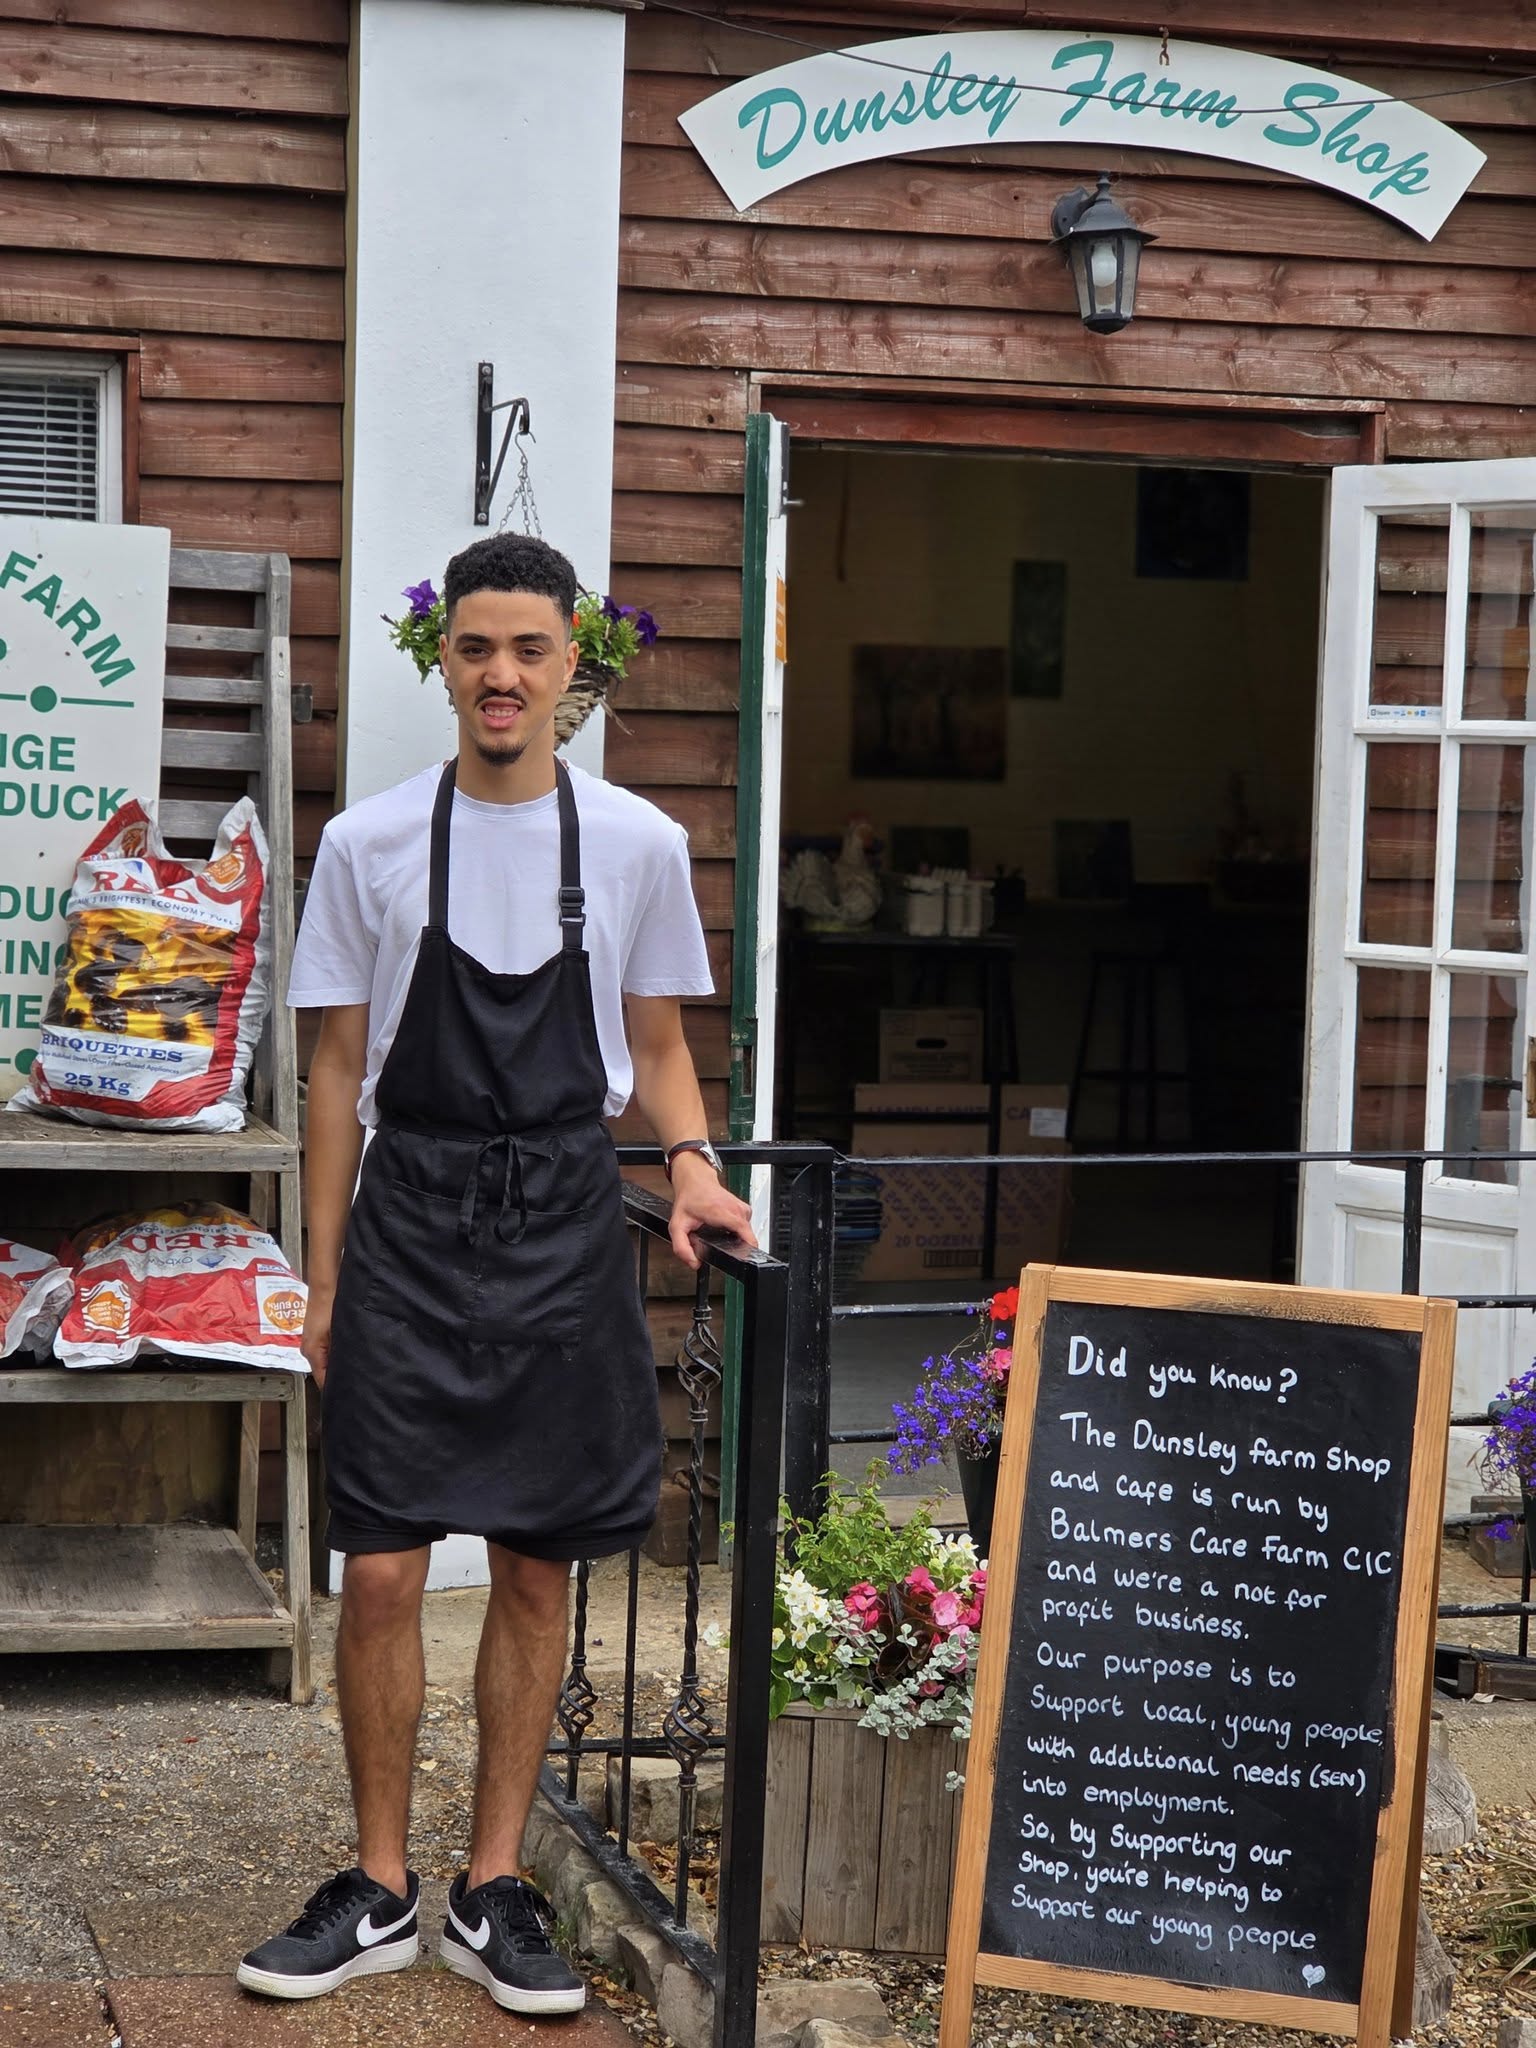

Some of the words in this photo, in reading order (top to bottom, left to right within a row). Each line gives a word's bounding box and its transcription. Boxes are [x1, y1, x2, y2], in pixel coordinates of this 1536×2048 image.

[738, 50, 1023, 171] Dunsley
[1051, 40, 1243, 130] Farm
[1261, 82, 1431, 198] Shop
[0, 551, 136, 688] FARM
[0, 733, 76, 771] GE
[0, 781, 129, 821] DUCK
[151, 896, 206, 917] ECONOMY
[42, 1033, 183, 1063] BRIQUETTES
[64, 1072, 93, 1087] 25
[99, 1076, 132, 1096] Kg
[119, 1232, 257, 1253] RED
[268, 1308, 307, 1320] READY
[293, 1300, 306, 1308] TO
[1068, 1336, 1126, 1377] Did
[1149, 1365, 1196, 1398] you
[1060, 1412, 1115, 1447] The
[1134, 1419, 1236, 1475] Dunsley
[1327, 1447, 1390, 1482] Shop
[1051, 1470, 1099, 1492] and
[1193, 1482, 1212, 1506] is
[1232, 1492, 1280, 1515] run
[1298, 1497, 1328, 1532] by
[1051, 1507, 1171, 1551] Balmers
[1190, 1527, 1247, 1557] Care
[1344, 1547, 1391, 1576] CIC
[1048, 1560, 1096, 1584] and
[1114, 1569, 1181, 1592] we're
[1201, 1581, 1218, 1596] a
[1235, 1583, 1275, 1604] not
[1285, 1589, 1326, 1611] for
[1043, 1597, 1113, 1626] profit
[1136, 1602, 1248, 1639] business.
[1037, 1642, 1086, 1668] Our
[1104, 1656, 1211, 1683] purpose
[1231, 1658, 1251, 1685] is
[1269, 1666, 1295, 1687] to
[1031, 1684, 1123, 1722] Support
[1144, 1700, 1215, 1730] local,
[1222, 1715, 1291, 1749] young
[1027, 1736, 1075, 1758] with
[1090, 1744, 1219, 1776] additional
[1234, 1764, 1301, 1787] needs
[1310, 1764, 1365, 1796] (SEN)
[1023, 1771, 1066, 1796] into
[1084, 1786, 1233, 1824] employment.
[1021, 1814, 1054, 1843] So,
[1070, 1818, 1095, 1858] by
[1111, 1824, 1236, 1873] Supporting
[1250, 1845, 1291, 1865] our
[1086, 1861, 1148, 1893] you're
[1165, 1870, 1249, 1912] helping
[1262, 1883, 1282, 1901] to
[1012, 1884, 1095, 1920] Support
[1106, 1908, 1141, 1924] our
[1151, 1913, 1213, 1950] young
[1228, 1925, 1315, 1953] people
